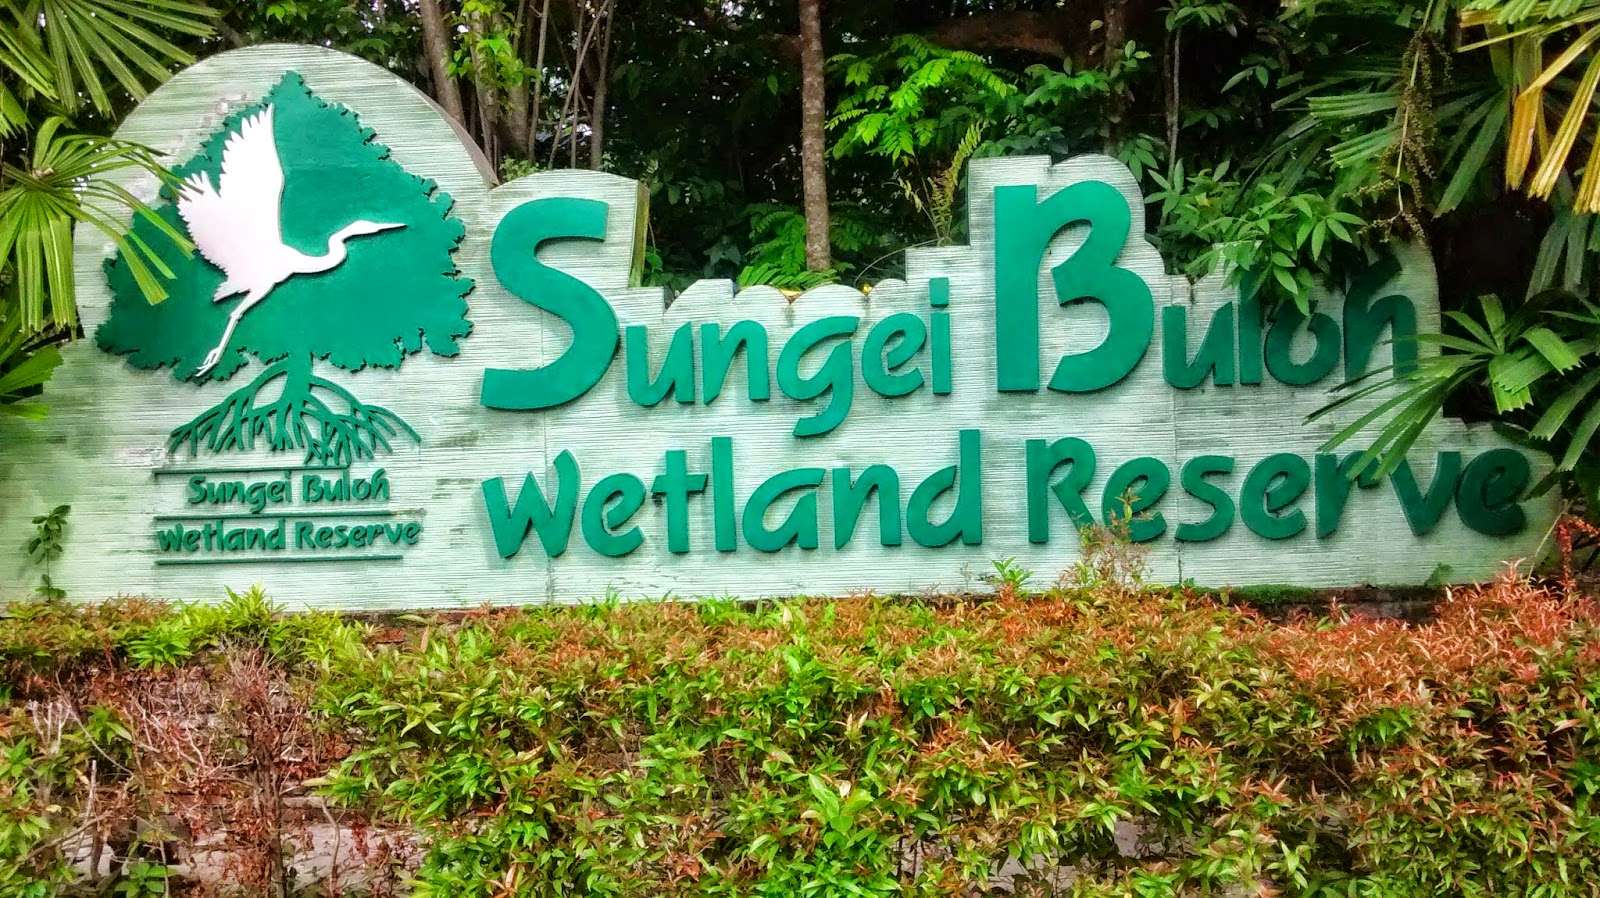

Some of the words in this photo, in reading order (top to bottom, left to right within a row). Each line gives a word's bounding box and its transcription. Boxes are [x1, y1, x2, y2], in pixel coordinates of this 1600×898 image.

[480, 197, 951, 436] Sungei
[995, 180, 1419, 393] Buloh
[188, 470, 292, 514] Sungei
[302, 468, 390, 501] Buloh
[483, 429, 982, 558] Wetland
[1026, 436, 1531, 544] Reserve
[157, 518, 286, 552] Wetland
[295, 520, 423, 549] Reserve
